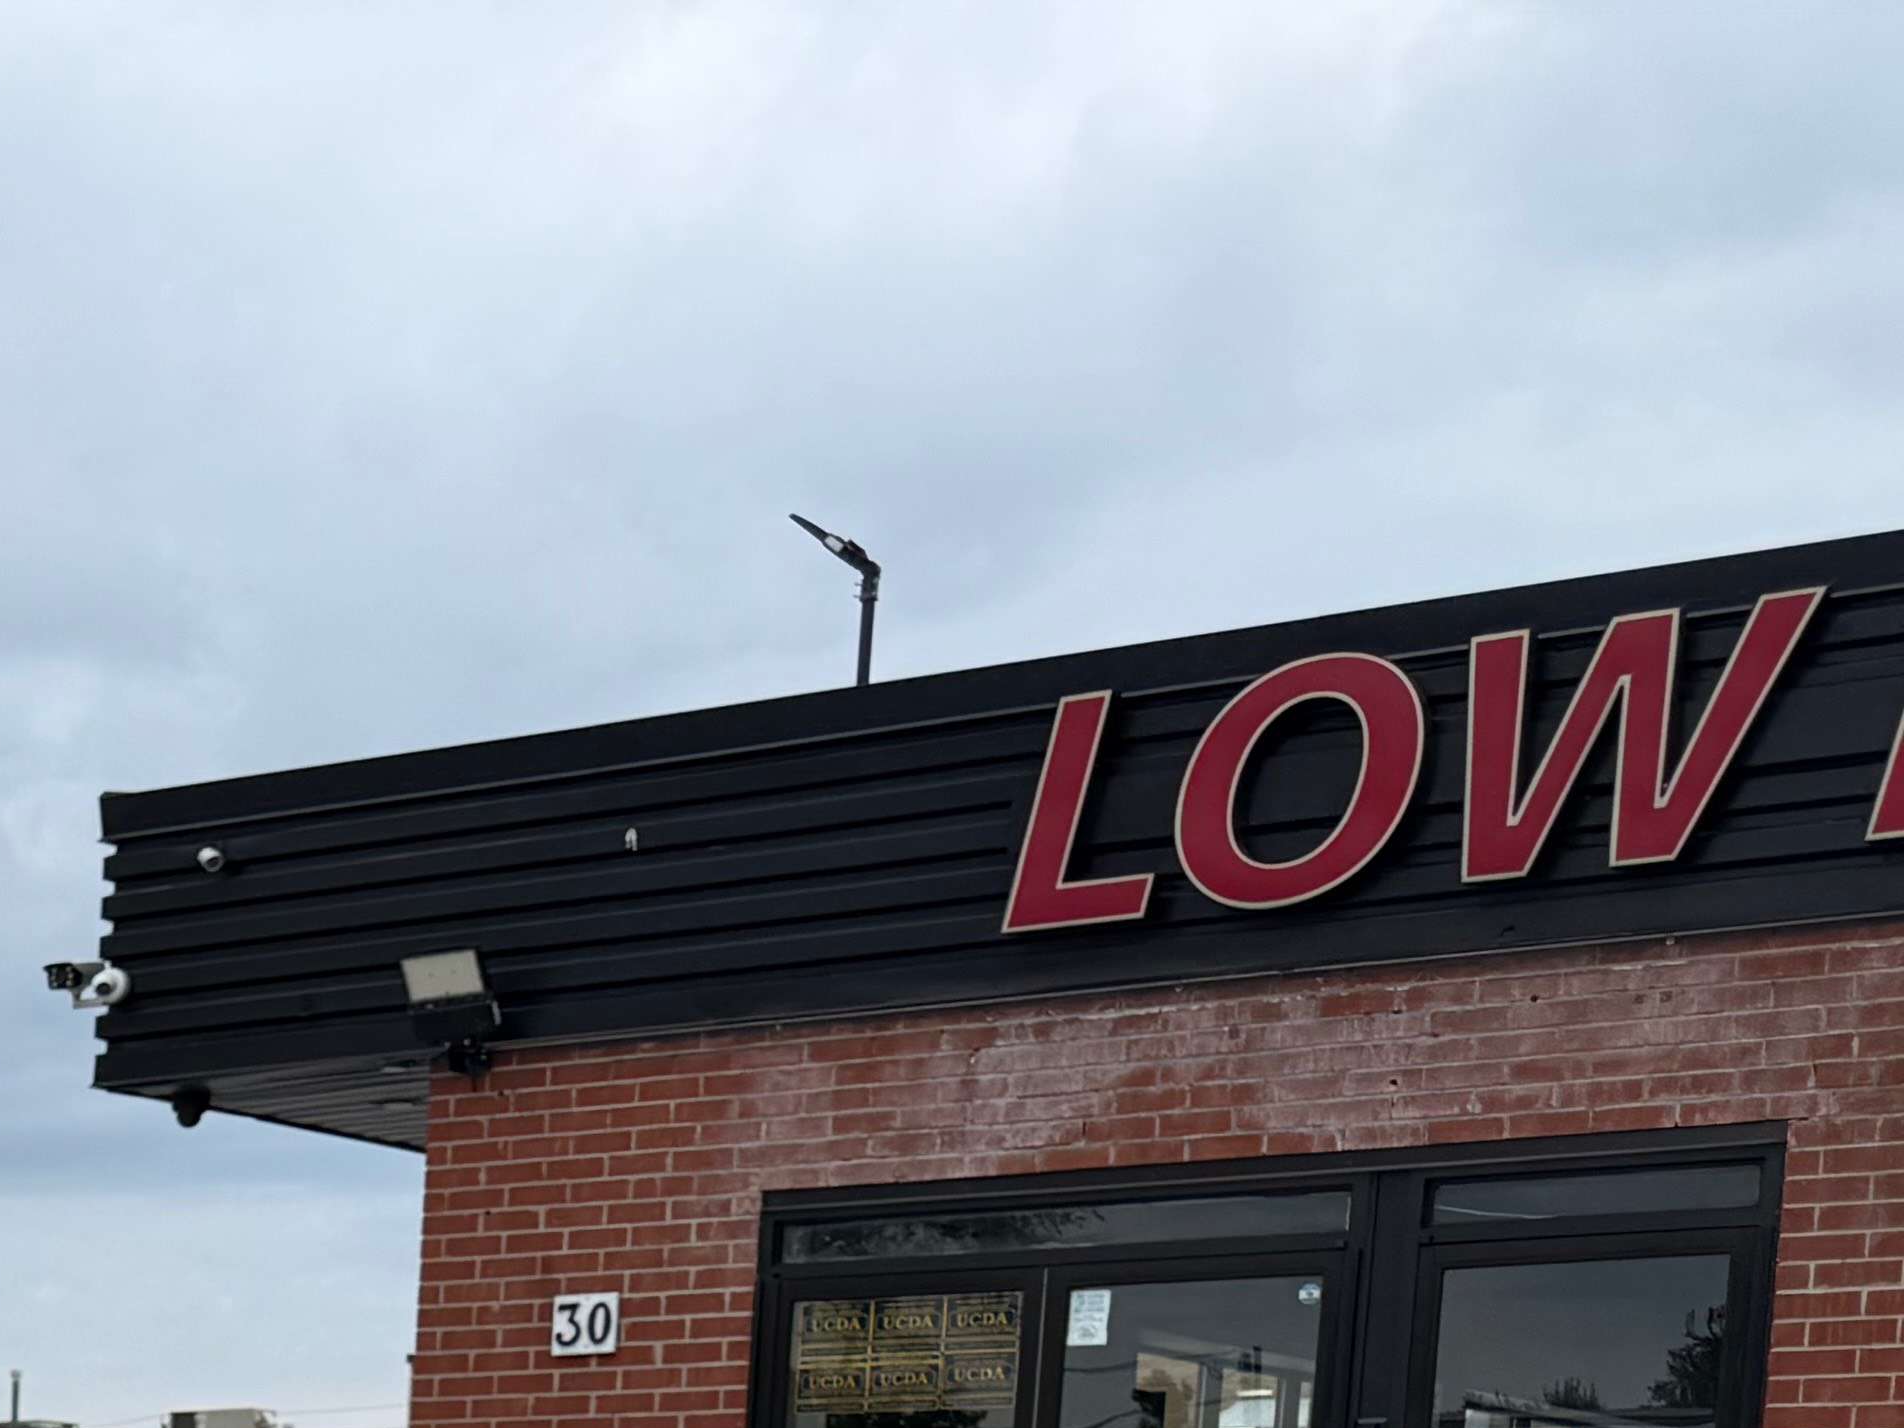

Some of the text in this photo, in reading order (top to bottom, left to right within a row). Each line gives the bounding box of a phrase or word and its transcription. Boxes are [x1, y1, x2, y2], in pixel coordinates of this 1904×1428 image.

[1000, 584, 1829, 935] LOW
[555, 1302, 613, 1346] 30
[811, 1316, 861, 1333] UCDA
[882, 1313, 934, 1330] UCDA
[955, 1311, 1008, 1328] UCDA
[809, 1374, 856, 1390] UCDA
[879, 1372, 929, 1387] UCDA
[953, 1365, 1006, 1382] UCDA
